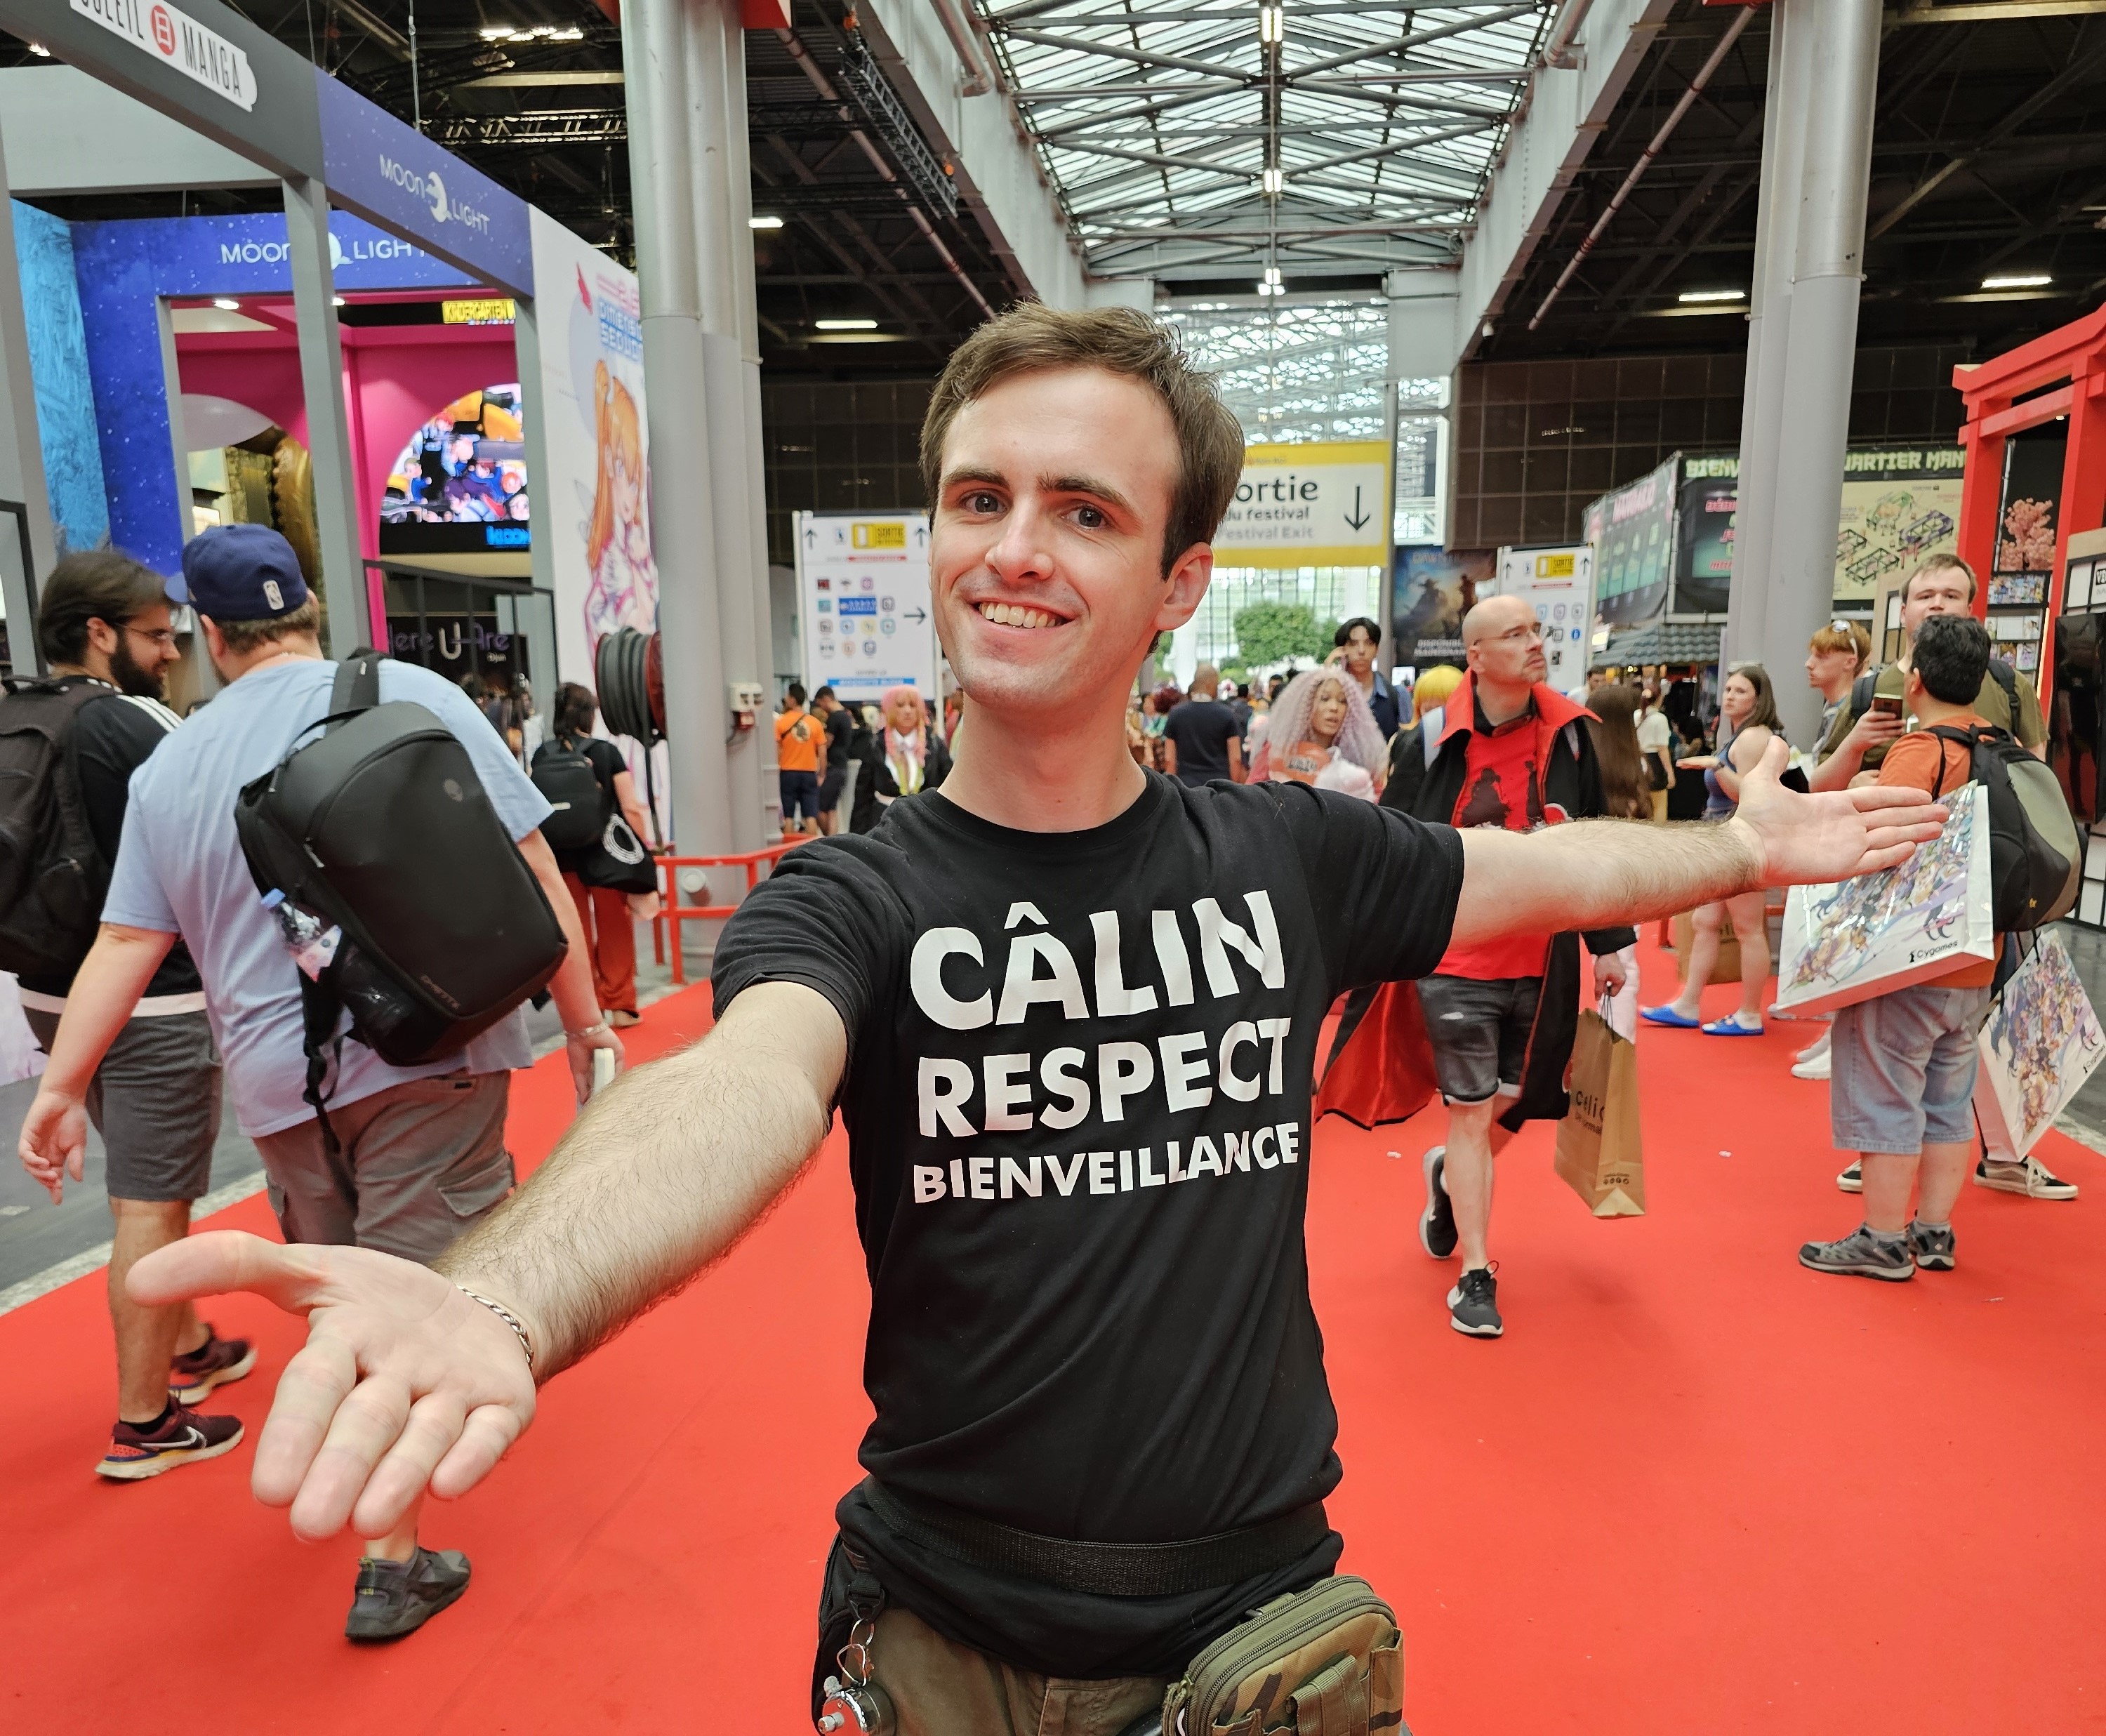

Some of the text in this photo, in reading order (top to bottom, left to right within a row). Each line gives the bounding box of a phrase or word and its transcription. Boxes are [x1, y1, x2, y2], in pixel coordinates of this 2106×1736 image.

[182, 20, 242, 98] MANGA
[451, 197, 491, 236] LIGHT
[1686, 449, 1966, 478] BIENV UARTIER MAN
[1235, 472, 1318, 502] ortie
[1246, 505, 1309, 521] festival
[1283, 526, 1313, 540] Exit
[438, 621, 462, 660] U
[910, 889, 1285, 1030] CÂLIN
[1916, 941, 1959, 959] Cygames
[918, 1017, 1290, 1138] RESPECT
[913, 1122, 1298, 1202] BIENVEILLANCE
